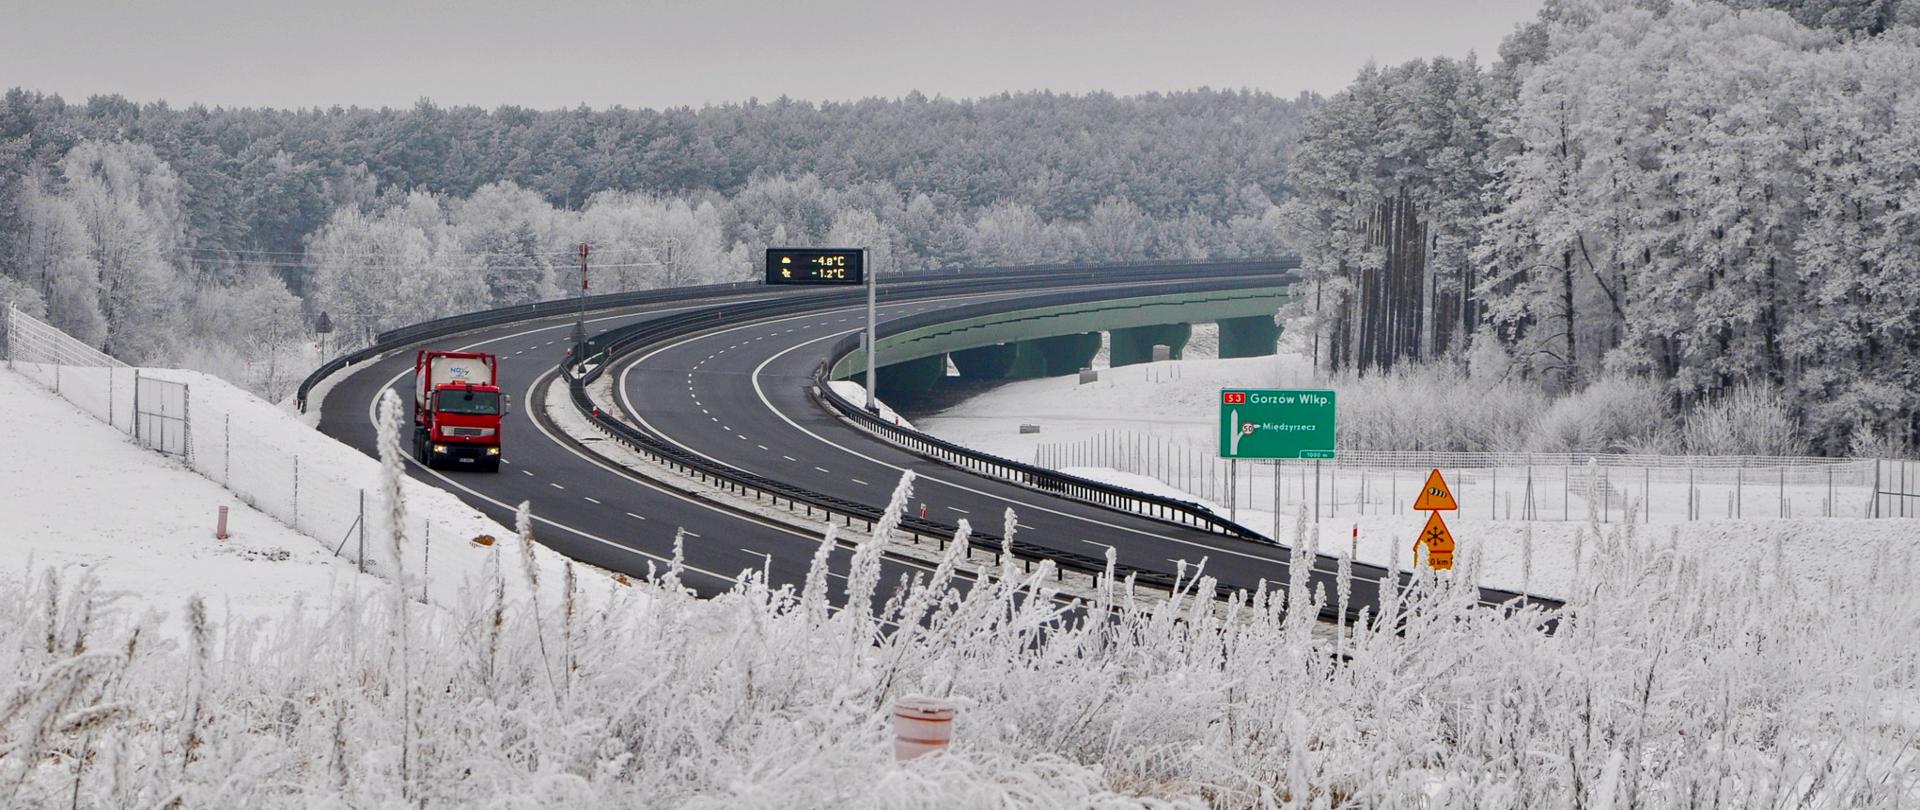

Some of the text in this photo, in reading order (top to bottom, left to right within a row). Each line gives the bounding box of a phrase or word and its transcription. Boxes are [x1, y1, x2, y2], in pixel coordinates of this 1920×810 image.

[811, 256, 845, 266] -4.8°C
[811, 268, 845, 278] -1.2°C
[1250, 393, 1332, 407] Gorzów Wlkp.
[1262, 422, 1316, 433] Międzyrzecz
